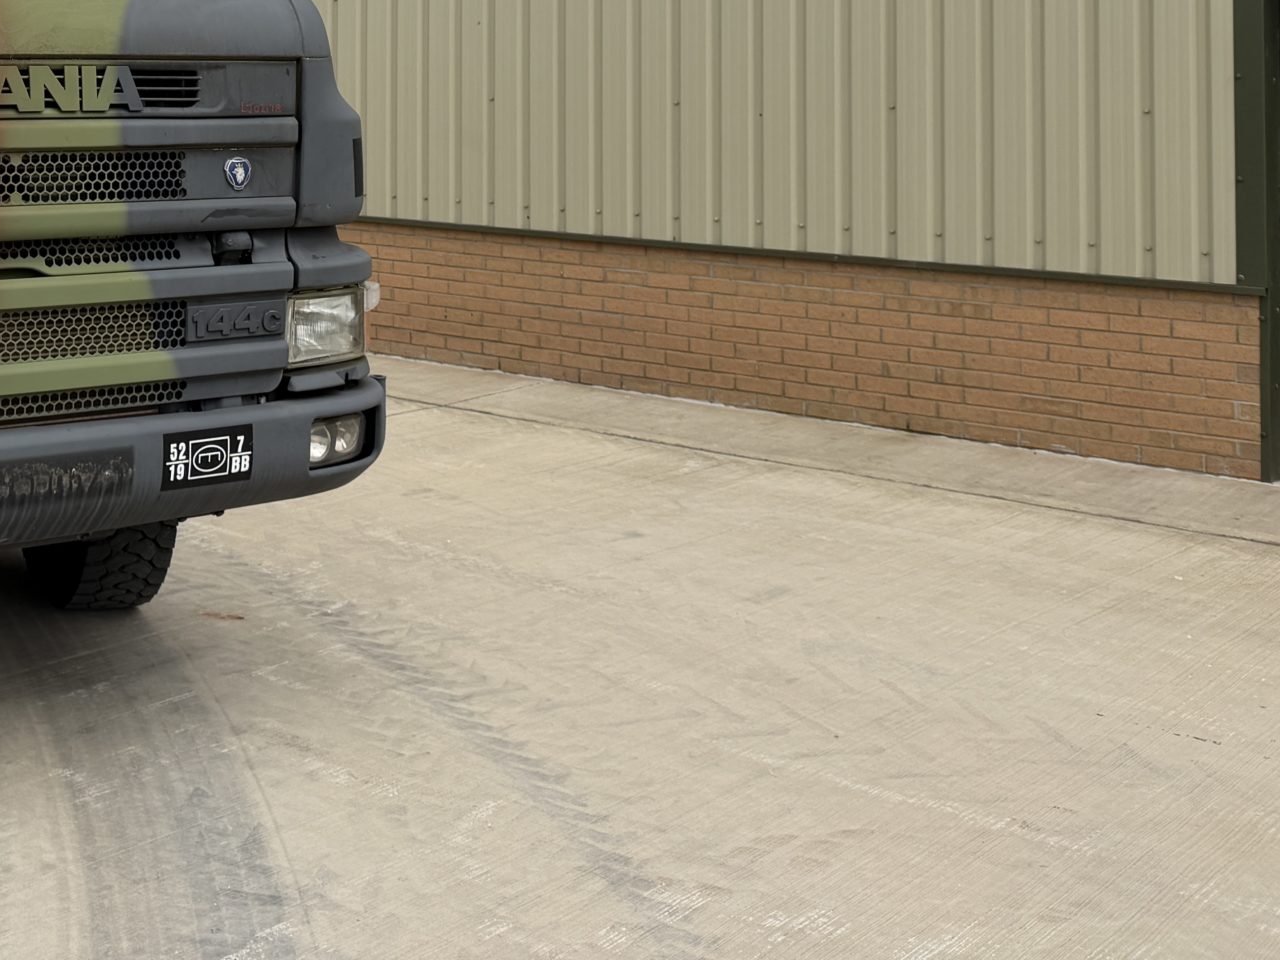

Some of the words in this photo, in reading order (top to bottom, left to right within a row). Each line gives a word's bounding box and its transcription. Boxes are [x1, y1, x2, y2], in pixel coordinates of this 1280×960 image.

[169, 442, 186, 461] 52
[236, 435, 245, 453] 7
[169, 463, 185, 482] 19
[230, 454, 250, 473] BB
